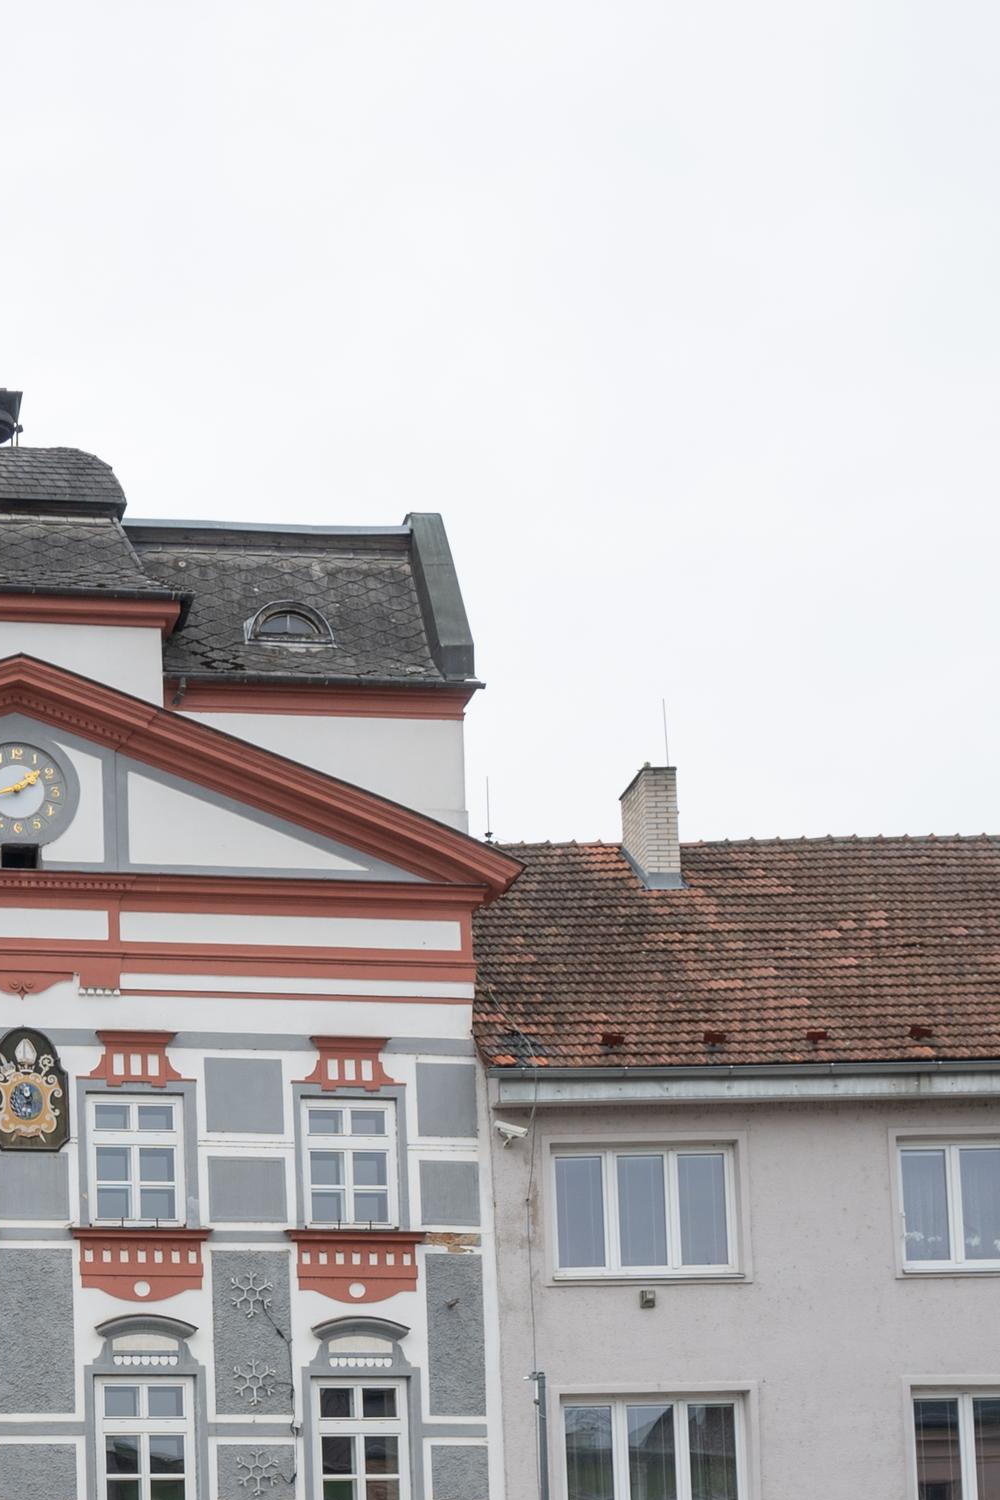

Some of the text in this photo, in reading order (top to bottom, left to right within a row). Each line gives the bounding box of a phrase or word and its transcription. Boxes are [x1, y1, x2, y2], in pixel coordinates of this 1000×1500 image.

[11, 748, 23, 760] 12
[32, 753, 37, 764] 1
[44, 768, 54, 779] 2
[50, 786, 60, 798] 3
[13, 822, 23, 833] 6
[33, 818, 41, 829] 5
